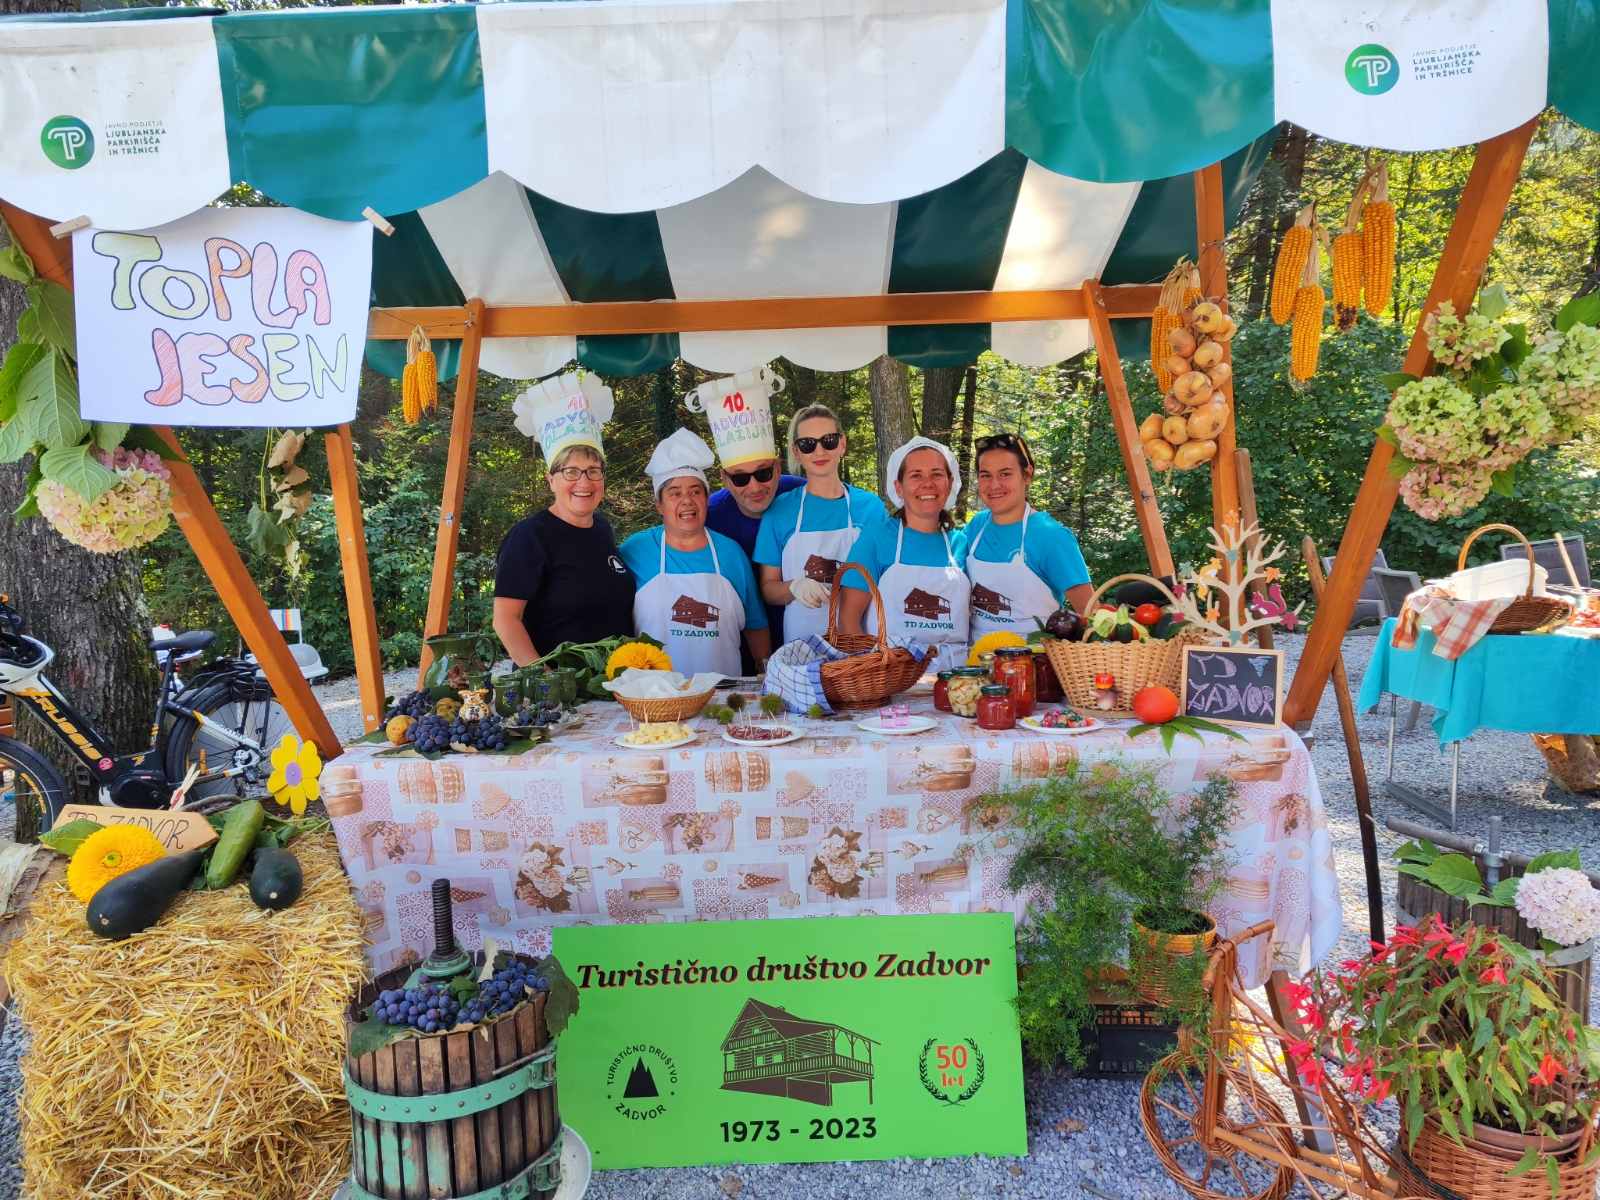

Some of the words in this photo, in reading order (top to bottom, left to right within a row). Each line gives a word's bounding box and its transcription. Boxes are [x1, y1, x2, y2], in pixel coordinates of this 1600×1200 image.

[1412, 50, 1481, 65] LJUBLJANSKA
[1414, 59, 1475, 73] PARKIRIŠČA
[1430, 67, 1473, 79] TRŽNICE
[106, 128, 167, 139] LJUBLJANSKA
[107, 137, 161, 147] PARKIRIŠČA
[109, 148, 119, 156] IN
[122, 145, 159, 155] TRŽNICE
[92, 231, 331, 328] TOPLA
[144, 328, 348, 406] JESEN
[723, 391, 750, 413] 10.
[919, 622, 954, 630] ZADVOR
[1188, 678, 1275, 716] ZADVOR
[577, 959, 738, 989] Turistično
[747, 955, 867, 982] društvo
[874, 951, 990, 978] Zadvor
[607, 1044, 646, 1085] TURISTIČNO
[649, 1045, 678, 1083] DRUŠTVO
[937, 1045, 967, 1069] 50
[943, 1072, 963, 1087] let
[615, 1102, 667, 1120] ZADVOR
[720, 1120, 780, 1142] 1973
[809, 1117, 876, 1140] 2023
